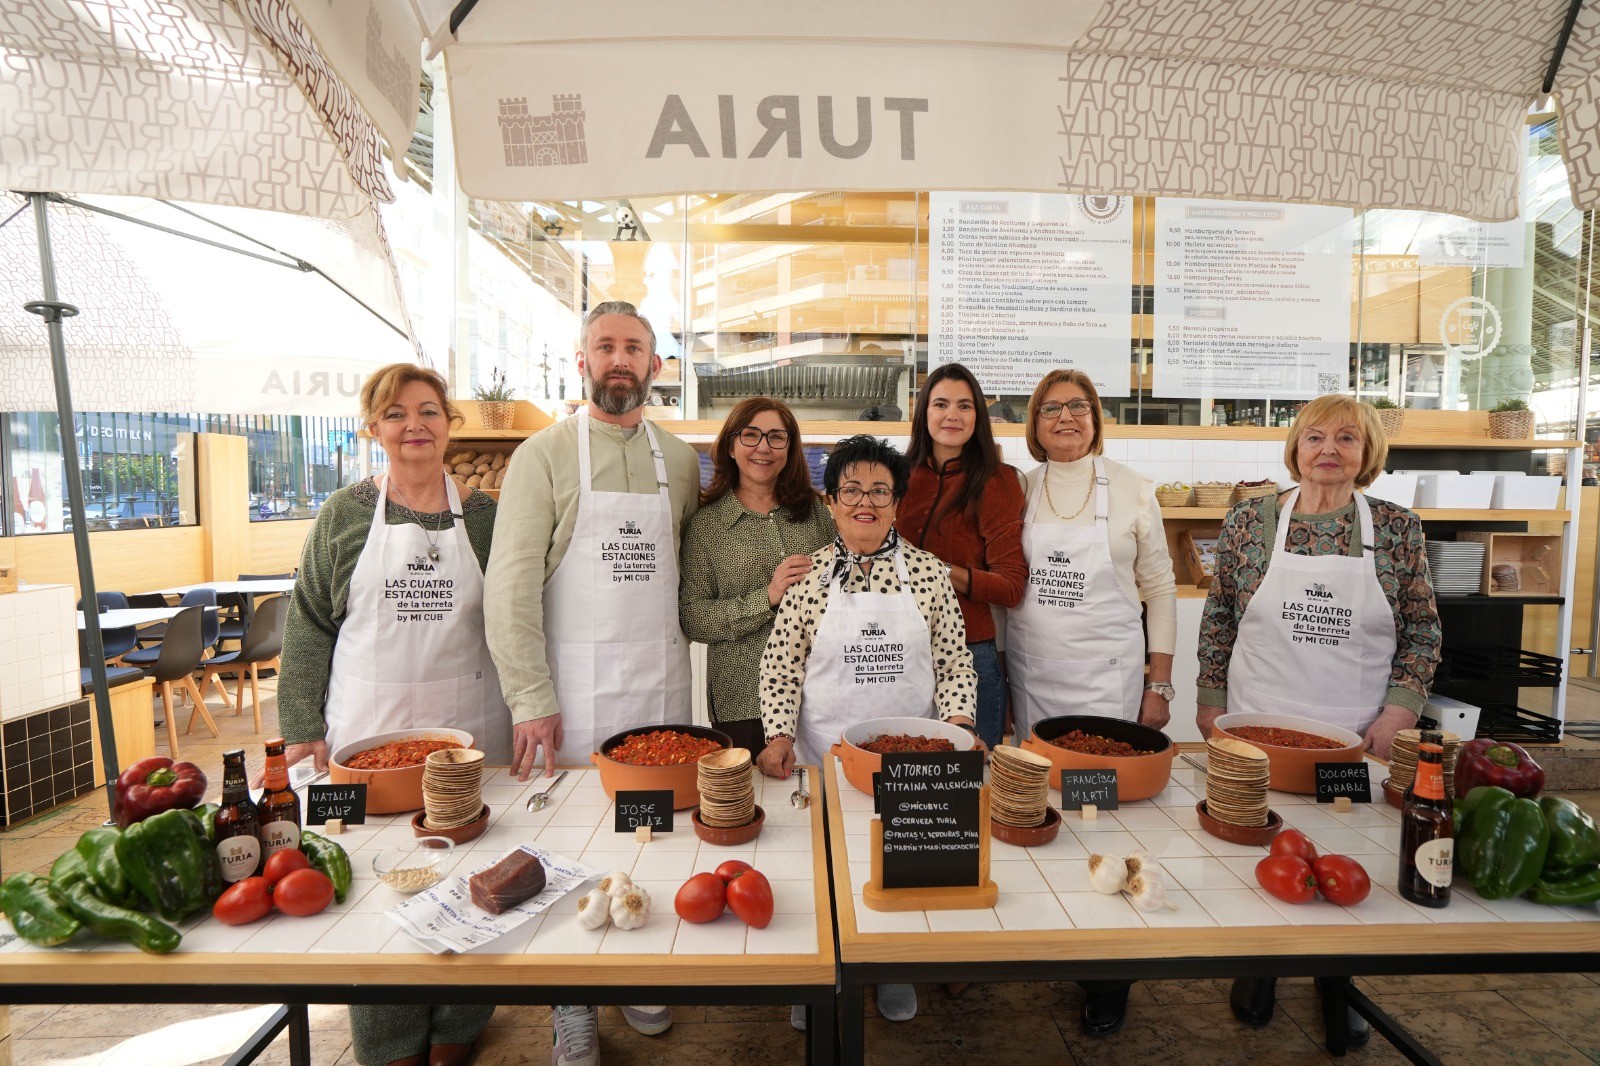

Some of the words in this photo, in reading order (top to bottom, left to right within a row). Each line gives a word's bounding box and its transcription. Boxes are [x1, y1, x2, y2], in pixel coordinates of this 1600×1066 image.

[1462, 320, 1480, 332] Café
[90, 426, 152, 441] DECTHLN
[622, 543, 656, 551] CUATRO
[1031, 568, 1046, 576] LAS
[1050, 570, 1084, 580] CUATRO
[386, 580, 406, 588] LAS
[410, 580, 453, 588] CUATRO
[1031, 577, 1084, 590] ESTACIONES
[385, 590, 452, 598] ESTACIONES
[1305, 590, 1333, 598] TURIA
[1284, 602, 1303, 611] LAS
[1307, 604, 1352, 617] CUATRO
[398, 614, 408, 622] by
[1282, 612, 1350, 626] ESTACIONES
[1318, 626, 1350, 635] terreta
[1293, 635, 1302, 643] by
[1319, 638, 1339, 646] CUB
[844, 645, 862, 653] LAS
[865, 644, 904, 652] CUATRO
[844, 654, 904, 663] ESTACIONES
[856, 677, 864, 685] by
[903, 764, 940, 776] TORNEO
[948, 764, 960, 774] DE
[1319, 768, 1366, 778] DOLORES
[1065, 773, 1117, 786] FRANCISCA
[885, 782, 928, 792] TITAINA
[932, 780, 983, 790] VALENCIANA
[312, 790, 356, 802] NATALIA
[318, 806, 352, 816] SANZ
[620, 804, 656, 814] JOSE
[892, 817, 934, 826] @CERVEZA
[936, 817, 957, 826] TURIA
[262, 837, 292, 848] TURIA
[222, 852, 252, 864] TURIA
